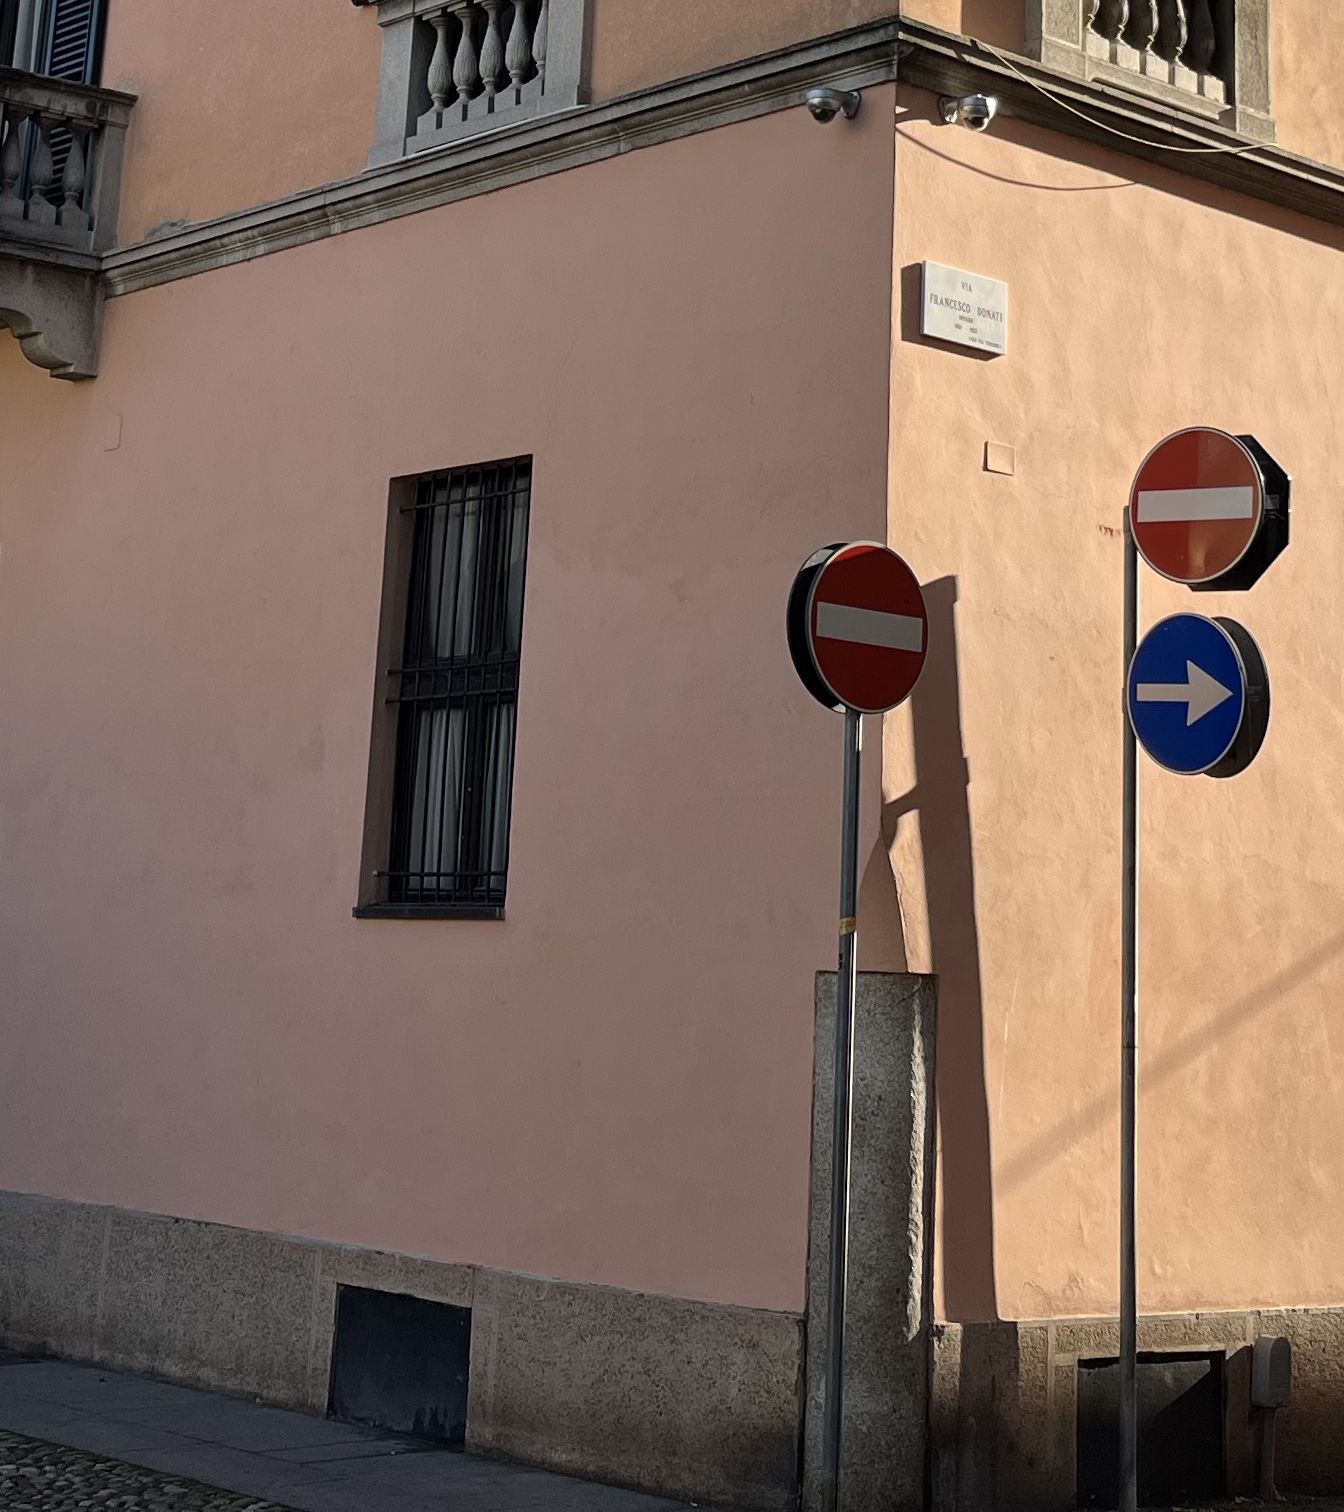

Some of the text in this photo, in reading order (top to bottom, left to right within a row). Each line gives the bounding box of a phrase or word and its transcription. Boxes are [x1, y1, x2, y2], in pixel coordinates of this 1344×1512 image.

[961, 281, 973, 293] VIA
[929, 293, 971, 314] FRANCESCO
[976, 306, 1003, 323] DONATI
